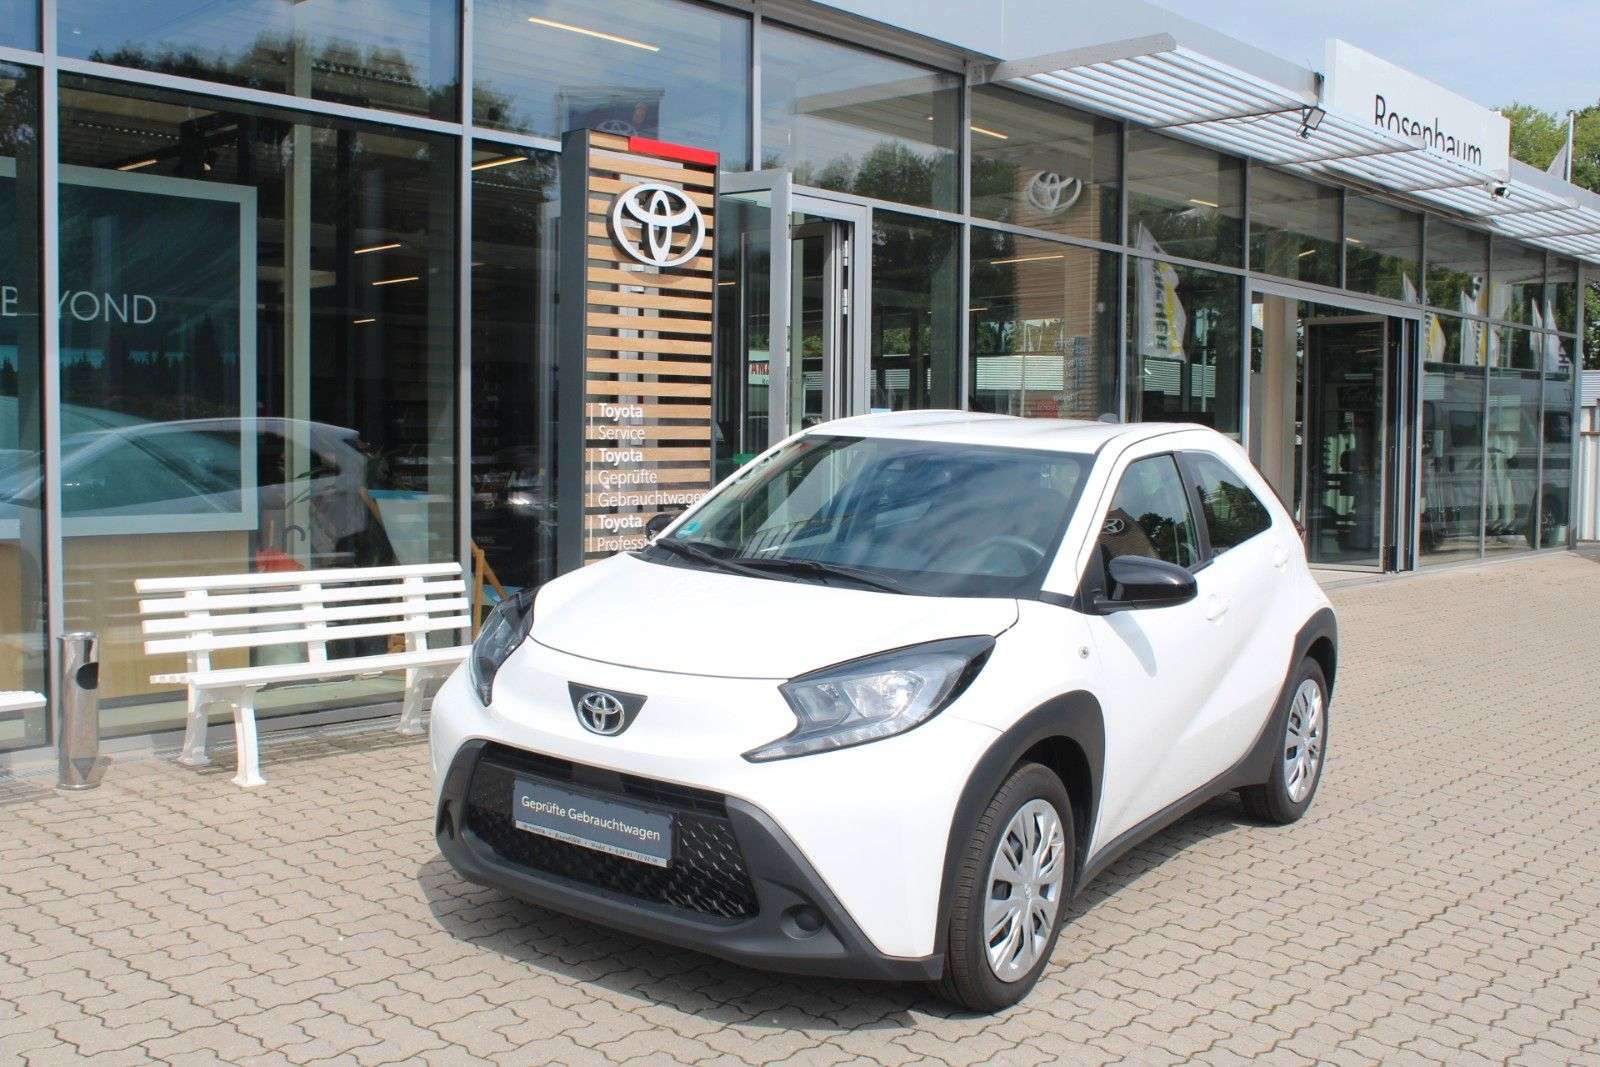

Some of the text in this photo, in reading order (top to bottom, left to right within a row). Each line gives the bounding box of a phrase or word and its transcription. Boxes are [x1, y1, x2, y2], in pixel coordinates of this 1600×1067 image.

[1374, 94, 1482, 166] Rosenbaum
[598, 404, 643, 421] Toyota
[598, 425, 645, 440] Service
[598, 448, 643, 466] Toyota
[598, 469, 657, 489] Geprüfte
[598, 491, 703, 508] Gebrauchtwage
[598, 515, 642, 532] Toyota
[598, 535, 648, 552] Professi
[521, 795, 661, 841] Geprüfte Gebrauchtwagen
